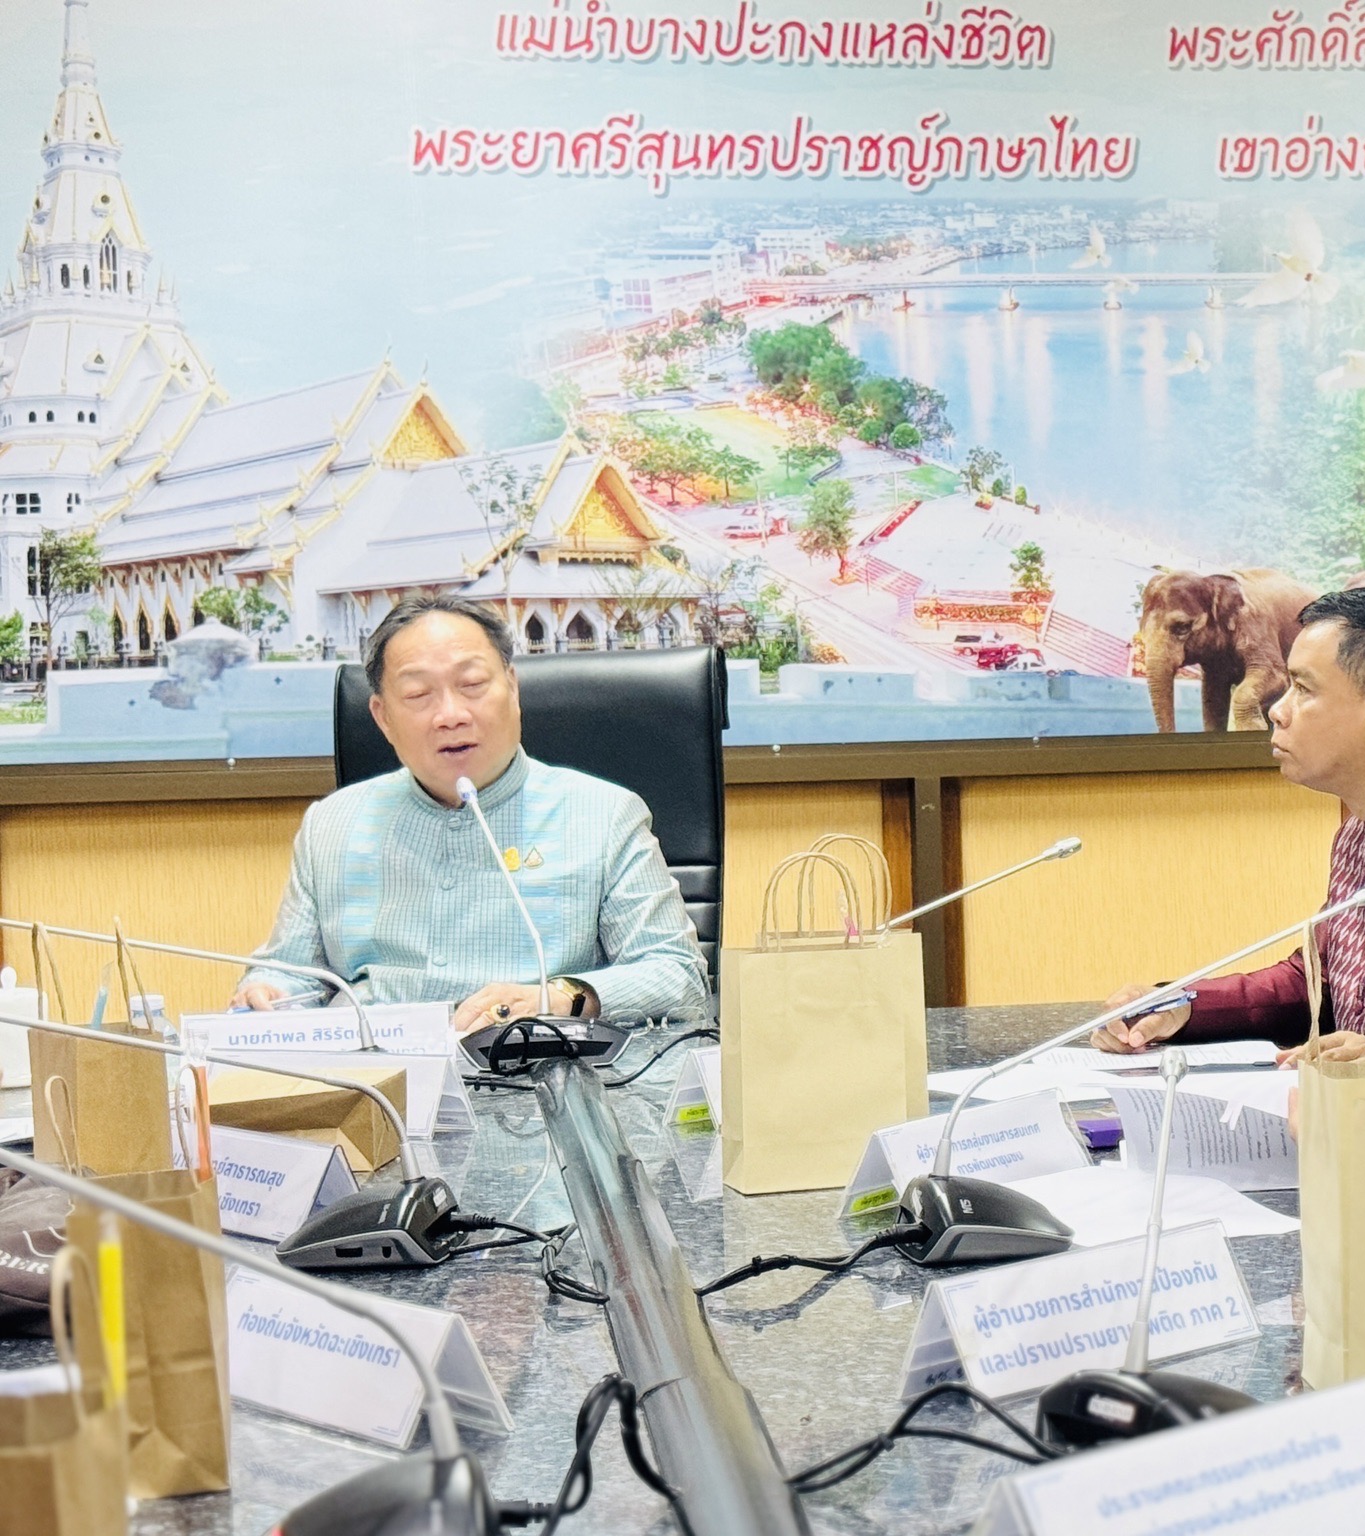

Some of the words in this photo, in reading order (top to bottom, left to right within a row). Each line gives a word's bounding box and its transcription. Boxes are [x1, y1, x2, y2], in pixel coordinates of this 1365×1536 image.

[496, 0, 1047, 62] แม่นำบางปะกงแหล่งชีวิต
[412, 114, 1132, 188] พระยาศรีสุนทรปราชญ์ภาษาไทย
[228, 1029, 306, 1046] นายกำพล
[237, 1306, 401, 1368] ท้องถิ่นจังหวัดฉะเชิงเทรา
[979, 1309, 1187, 1376] และปราบปรามยาพติด
[1191, 1301, 1225, 1327] ภาค
[1225, 1296, 1241, 1317] 2
